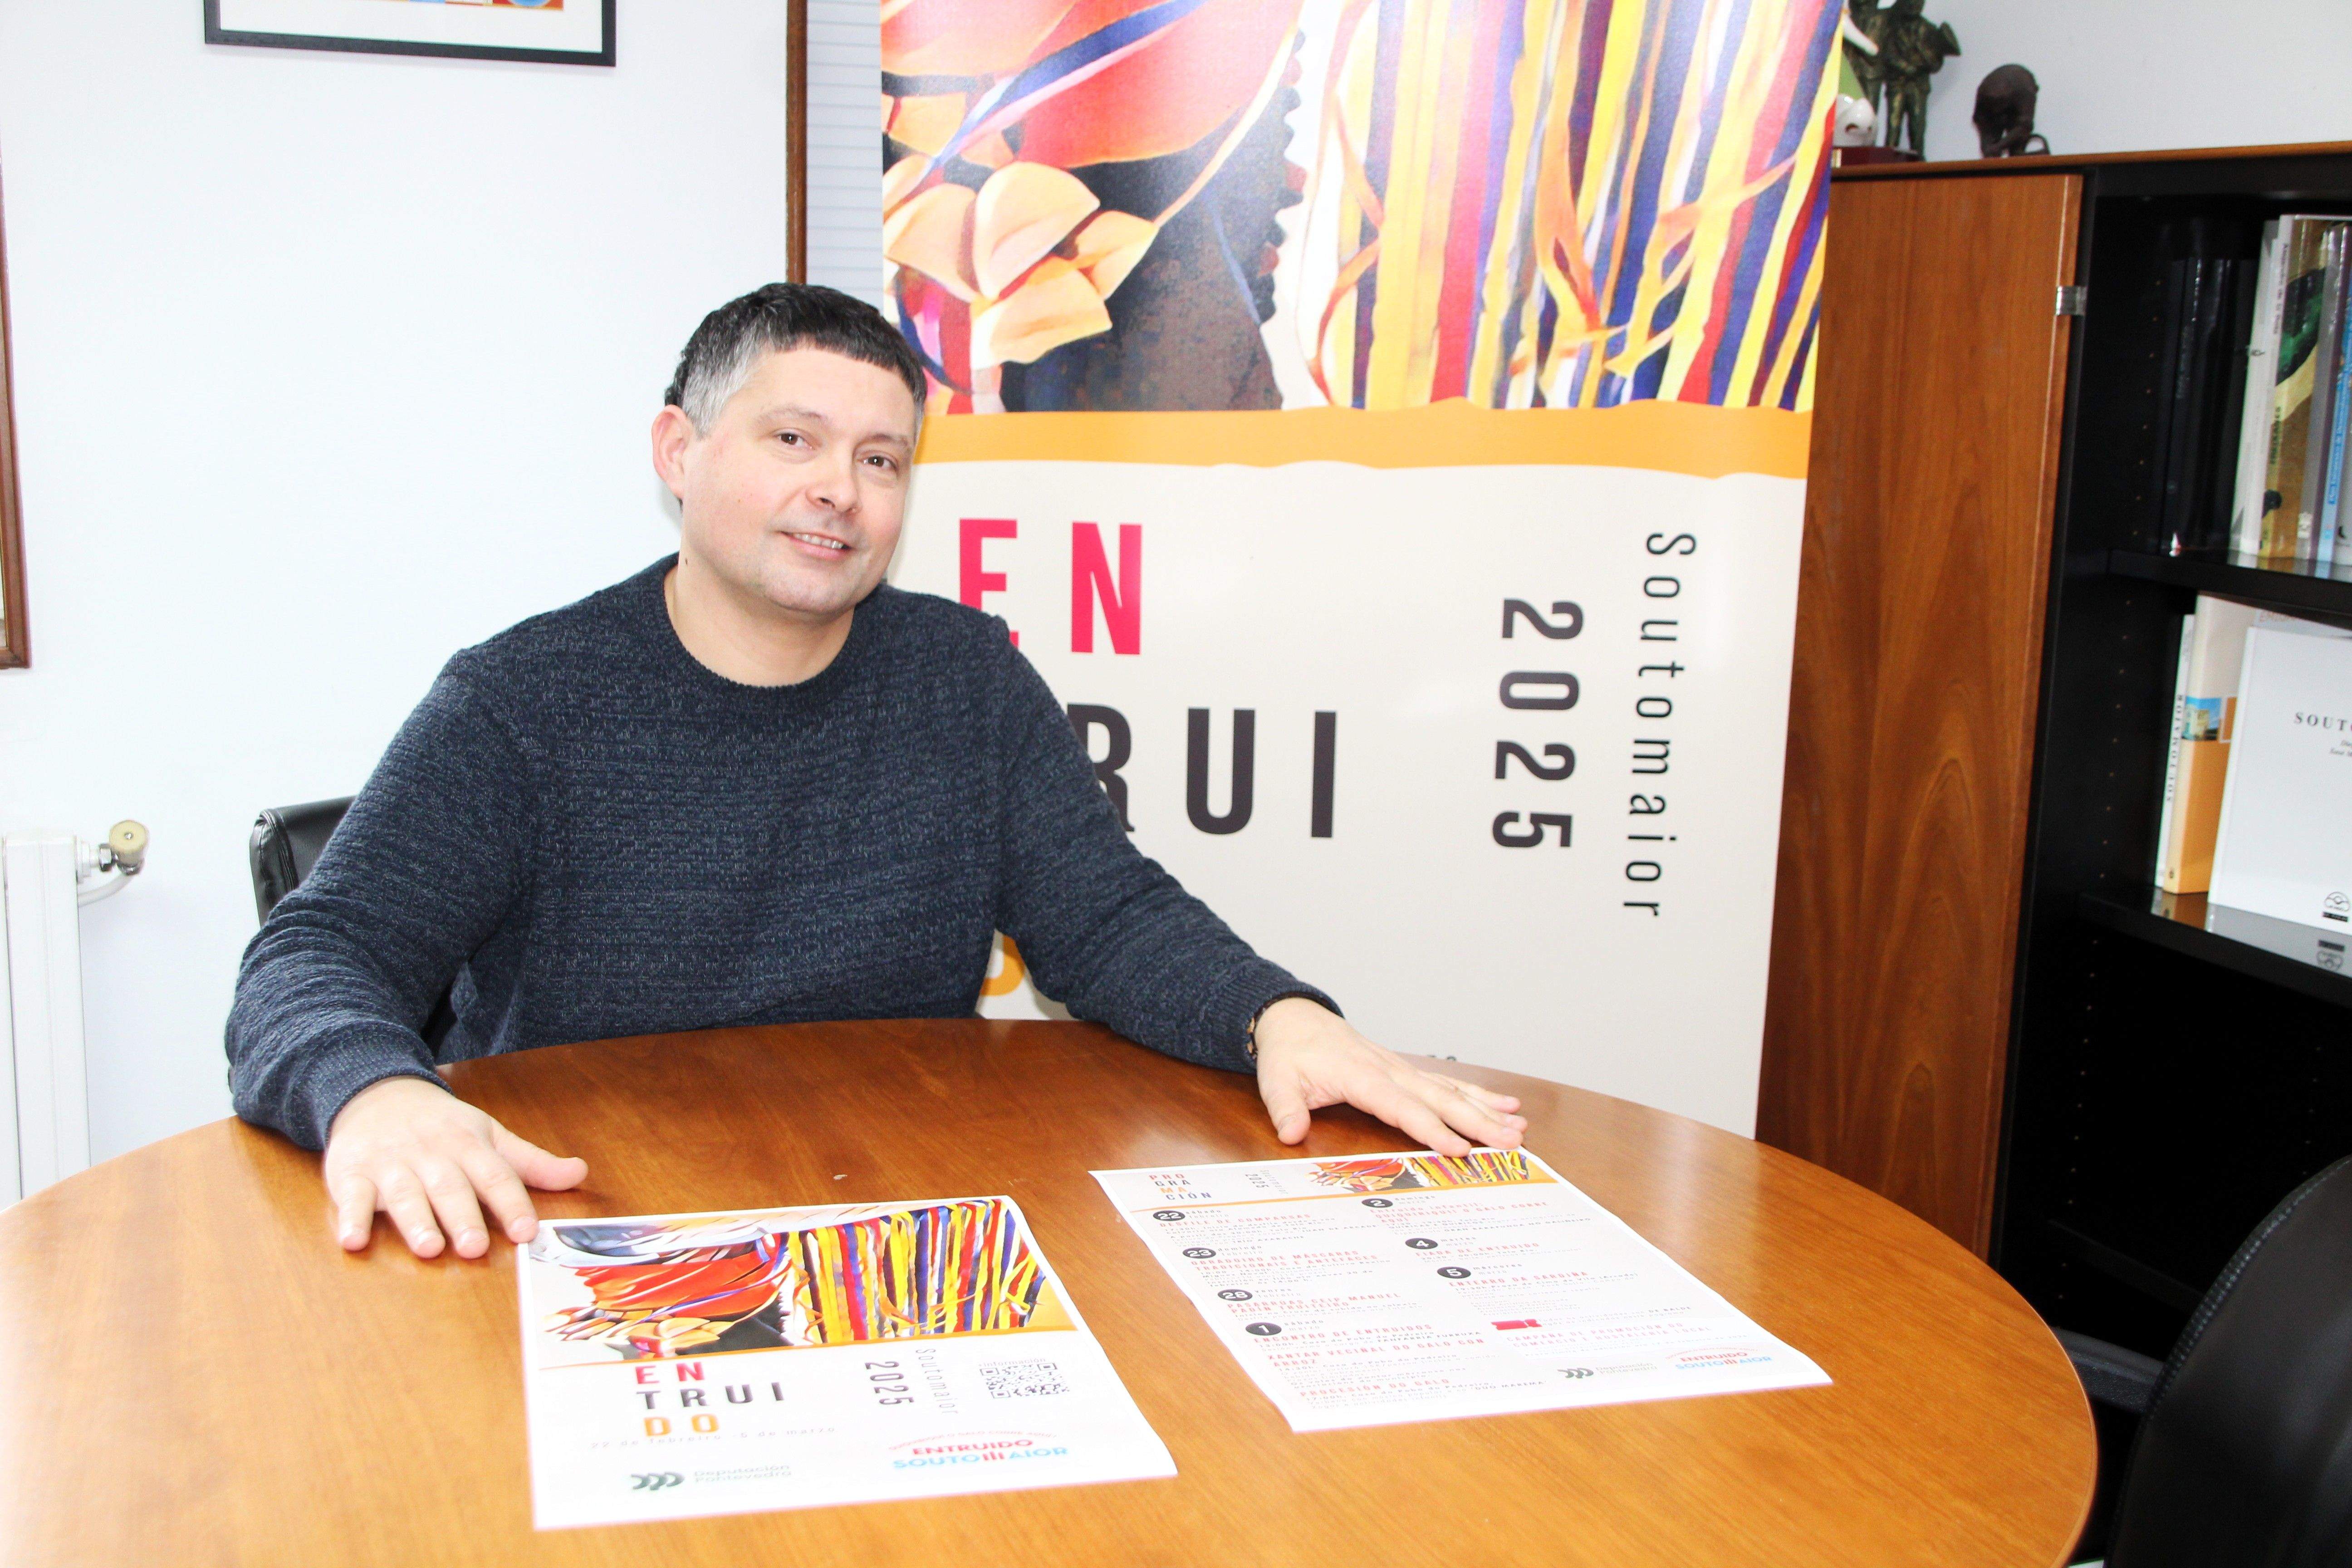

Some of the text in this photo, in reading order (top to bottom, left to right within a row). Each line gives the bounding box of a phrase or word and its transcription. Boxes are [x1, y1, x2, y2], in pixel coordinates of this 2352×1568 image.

[960, 518, 1142, 656] EN
[1492, 598, 1584, 848] 2025
[1622, 532, 1697, 916] Soutomaior
[2294, 711, 2352, 731] SOUT
[1067, 703, 1337, 838] RUI
[1245, 1173, 1269, 1187] 2025
[1196, 1262, 1287, 1271] TRADICIONAIS
[1308, 1255, 1377, 1264] ANTEFACES
[1292, 1250, 1358, 1259] MÁSCARAS
[1254, 1333, 1325, 1343] ENCONTRO
[1356, 1324, 1431, 1334] ENTRUIDOS
[1513, 1338, 1576, 1347] COMERCIO
[1680, 1352, 1748, 1362] ENTRUIDO
[636, 1362, 705, 1384] EN
[915, 1348, 958, 1414] Soutomaior
[865, 1361, 914, 1405] 2025
[1299, 1385, 1381, 1396] PROCESIÓN
[636, 1382, 784, 1409] TRUI
[643, 1414, 720, 1436] DO
[649, 1434, 722, 1444] febreiro
[786, 1427, 835, 1436] marzo
[912, 1439, 1034, 1455] ENTRUIDO
[694, 1465, 790, 1476] Deputación
[695, 1470, 792, 1483] Pontevedra
